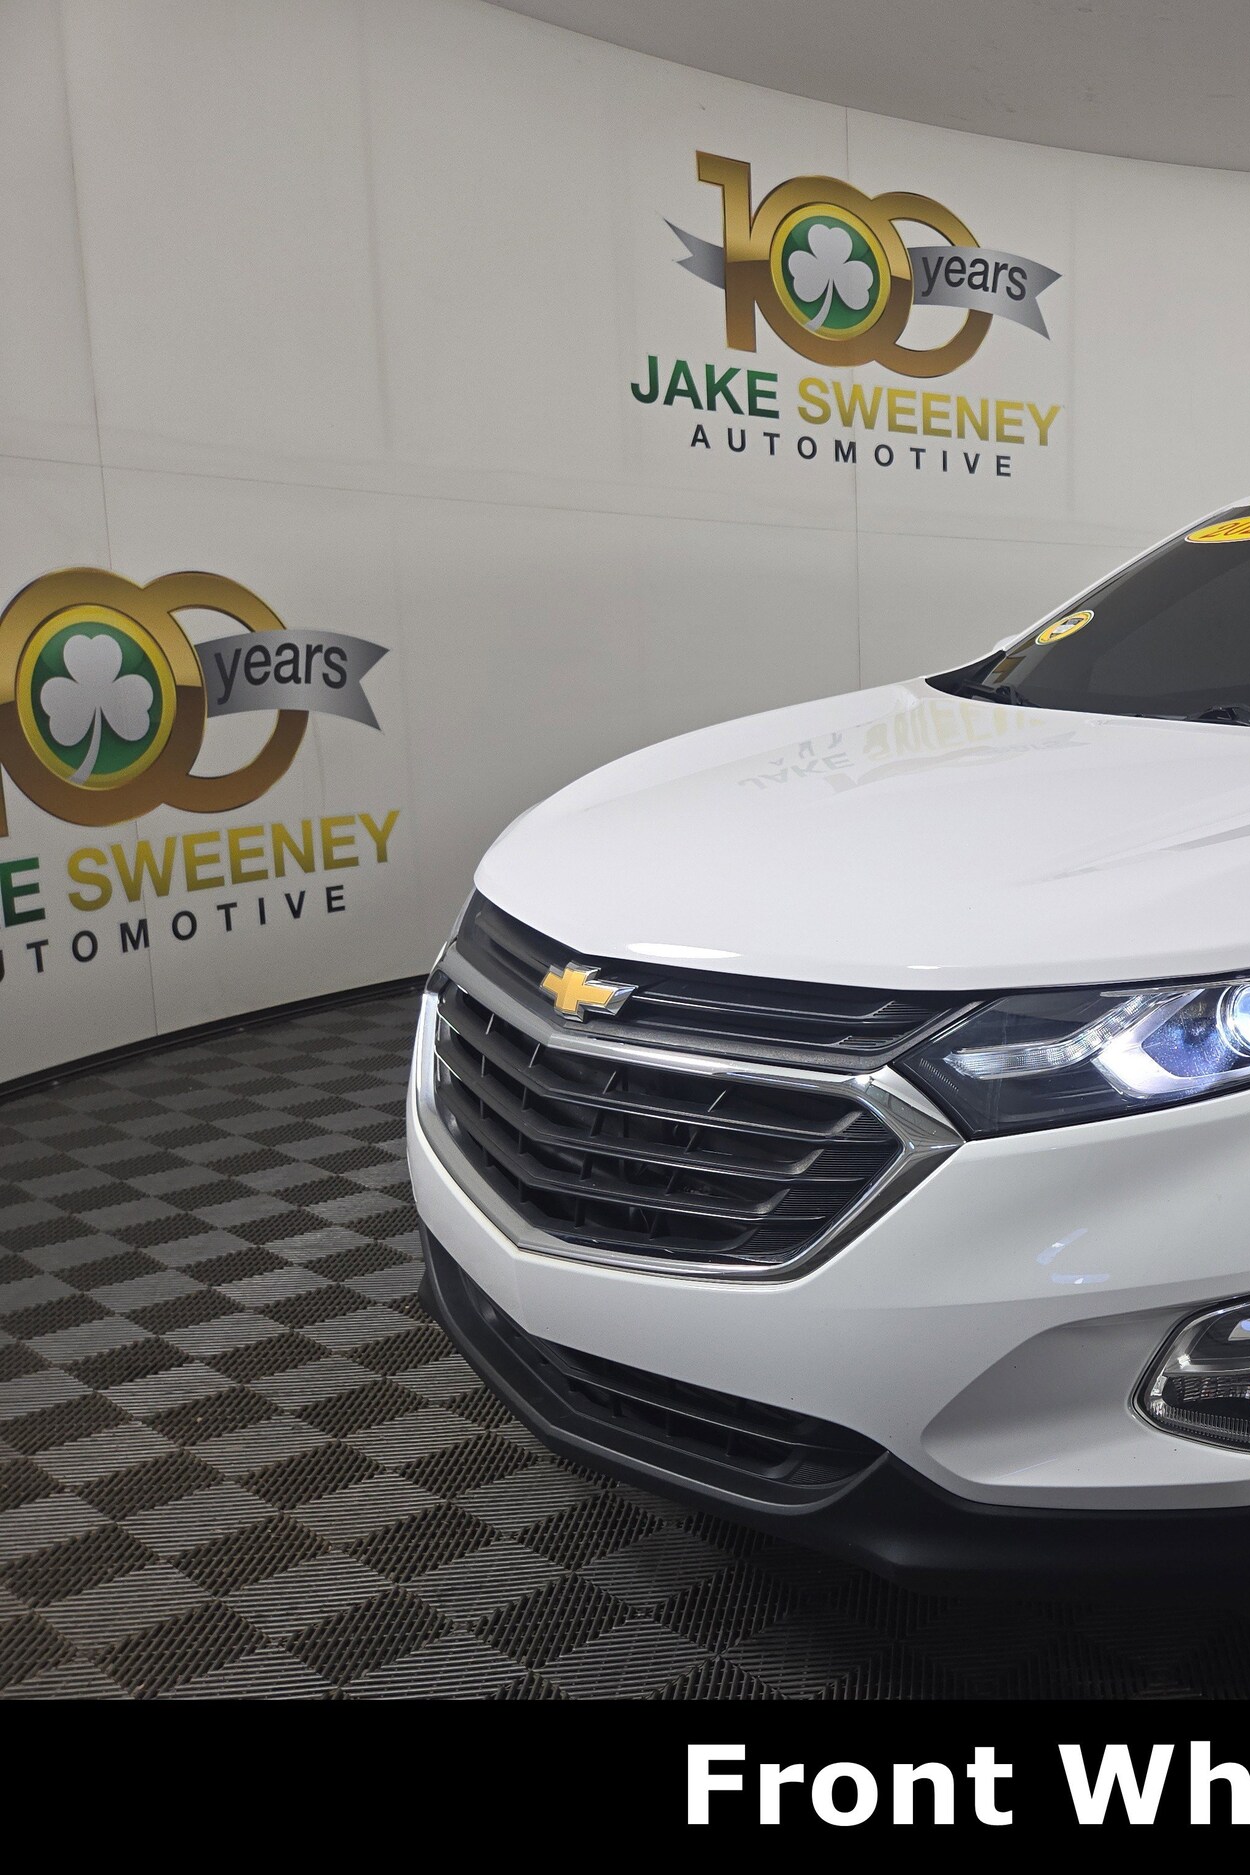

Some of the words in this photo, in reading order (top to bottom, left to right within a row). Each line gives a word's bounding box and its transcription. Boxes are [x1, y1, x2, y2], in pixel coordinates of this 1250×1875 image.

[920, 254, 1028, 301] years
[630, 355, 780, 420] JAKE
[797, 376, 1062, 447] SWEENEY
[690, 423, 1012, 478] AUTOMOTIVE
[0, 567, 310, 839] 00
[214, 641, 349, 705] years
[67, 808, 400, 913] SWEENEY
[0, 884, 347, 984] TOMOTIVE
